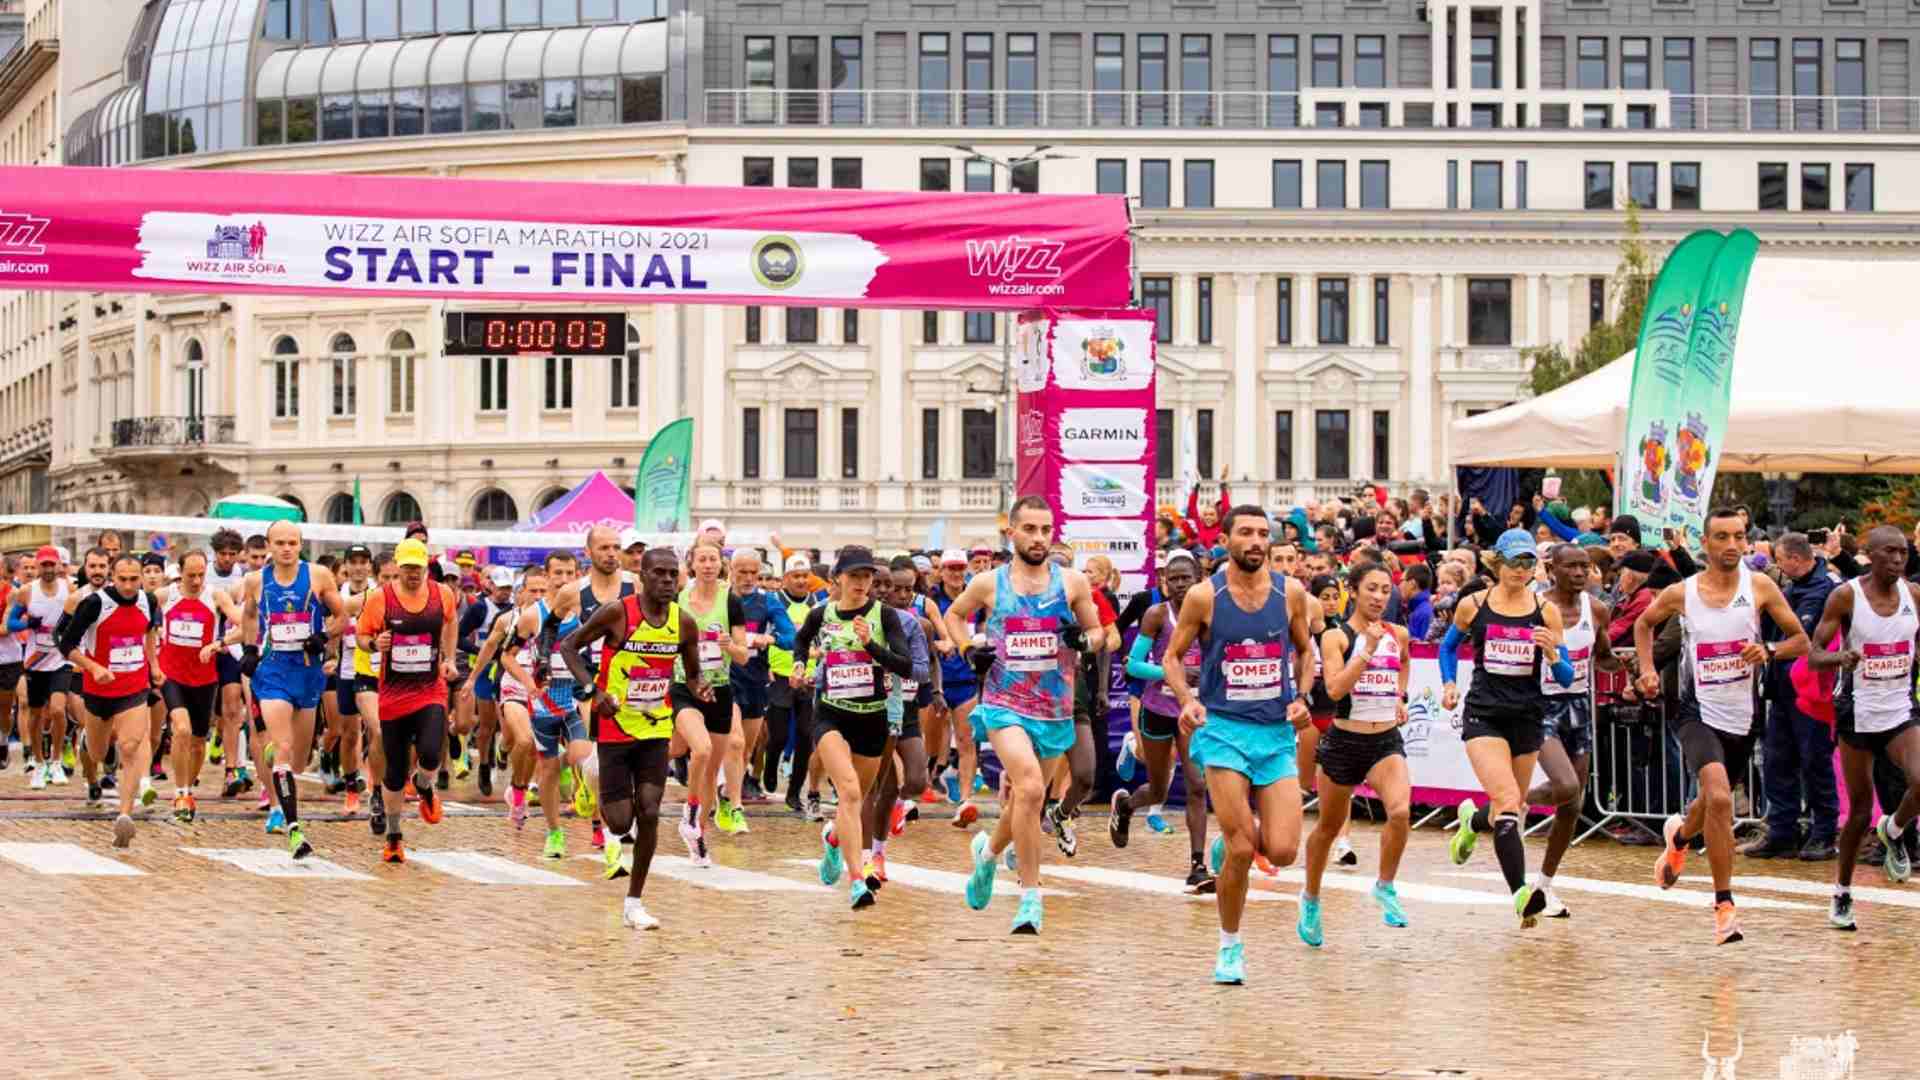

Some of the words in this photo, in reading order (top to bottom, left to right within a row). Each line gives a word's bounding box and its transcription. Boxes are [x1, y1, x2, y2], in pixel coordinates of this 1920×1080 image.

[325, 224, 384, 242] WIZZ
[393, 226, 432, 243] AIR
[440, 226, 510, 245] SOFIA
[520, 229, 651, 248] MARATHON
[660, 232, 709, 249] 2021
[186, 261, 219, 272] WIZZ
[223, 263, 246, 273] AIR
[248, 263, 286, 274] SOFIA
[324, 246, 494, 284] START
[514, 266, 530, 274] -
[552, 252, 707, 289] FINAL
[989, 283, 1065, 295] wizzair.com
[1064, 428, 1138, 440] GARMIN
[1010, 636, 1054, 649] AHMET
[831, 666, 870, 679] MILITSA
[1232, 664, 1277, 676] OMER
[633, 682, 666, 693] JEAN
